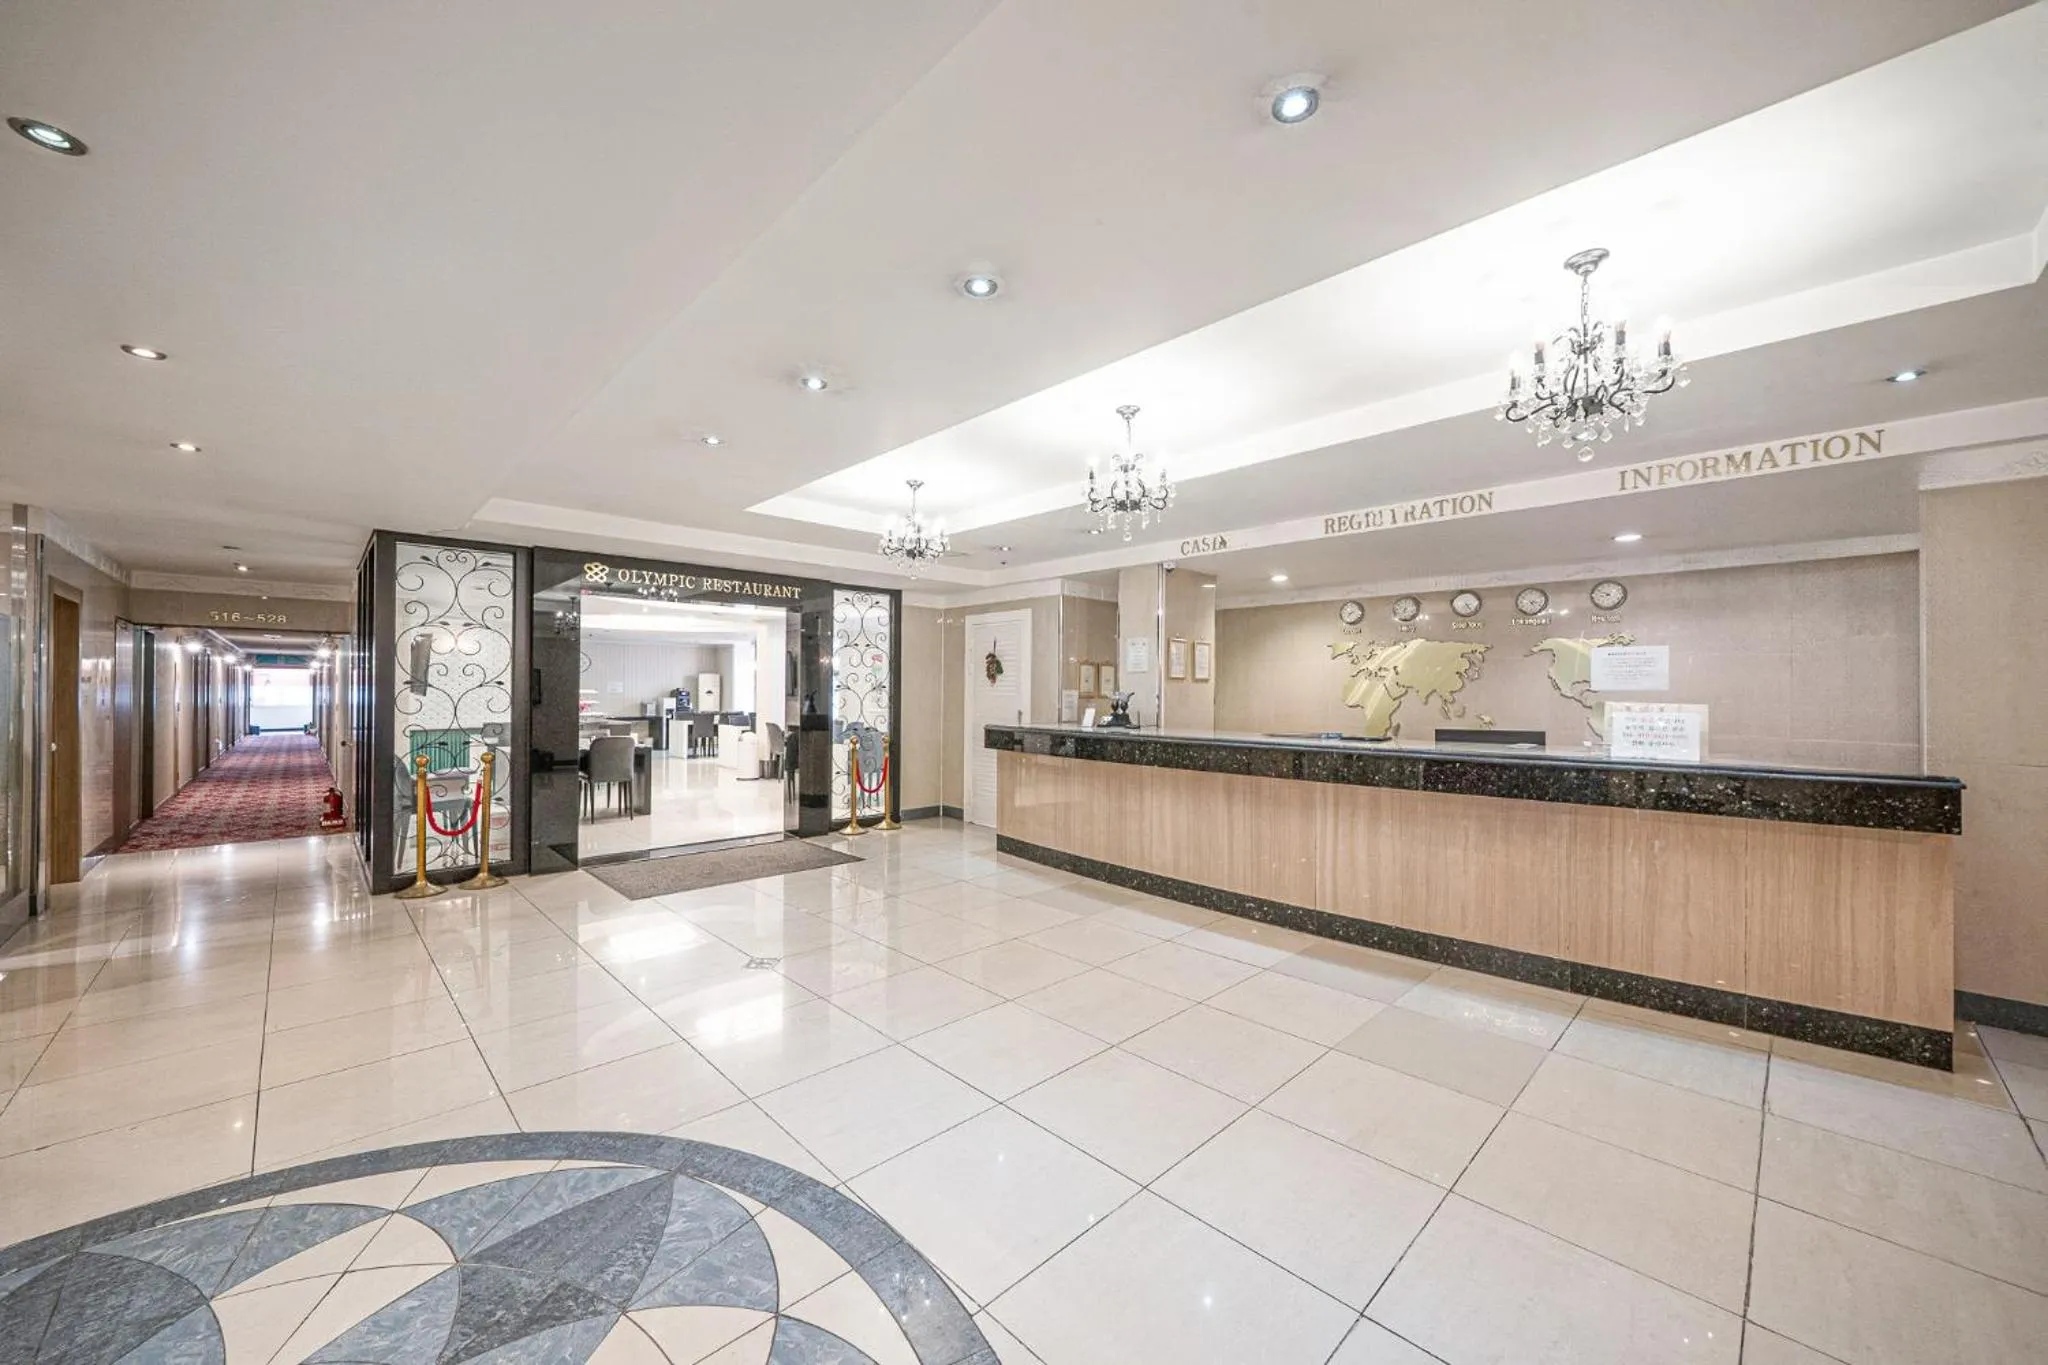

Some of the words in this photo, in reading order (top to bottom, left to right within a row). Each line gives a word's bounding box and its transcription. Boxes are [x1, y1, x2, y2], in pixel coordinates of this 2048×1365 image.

[1618, 429, 1885, 491] INFORMATION
[617, 567, 696, 589] OLYMPIC
[702, 577, 802, 600] RESTAURANT
